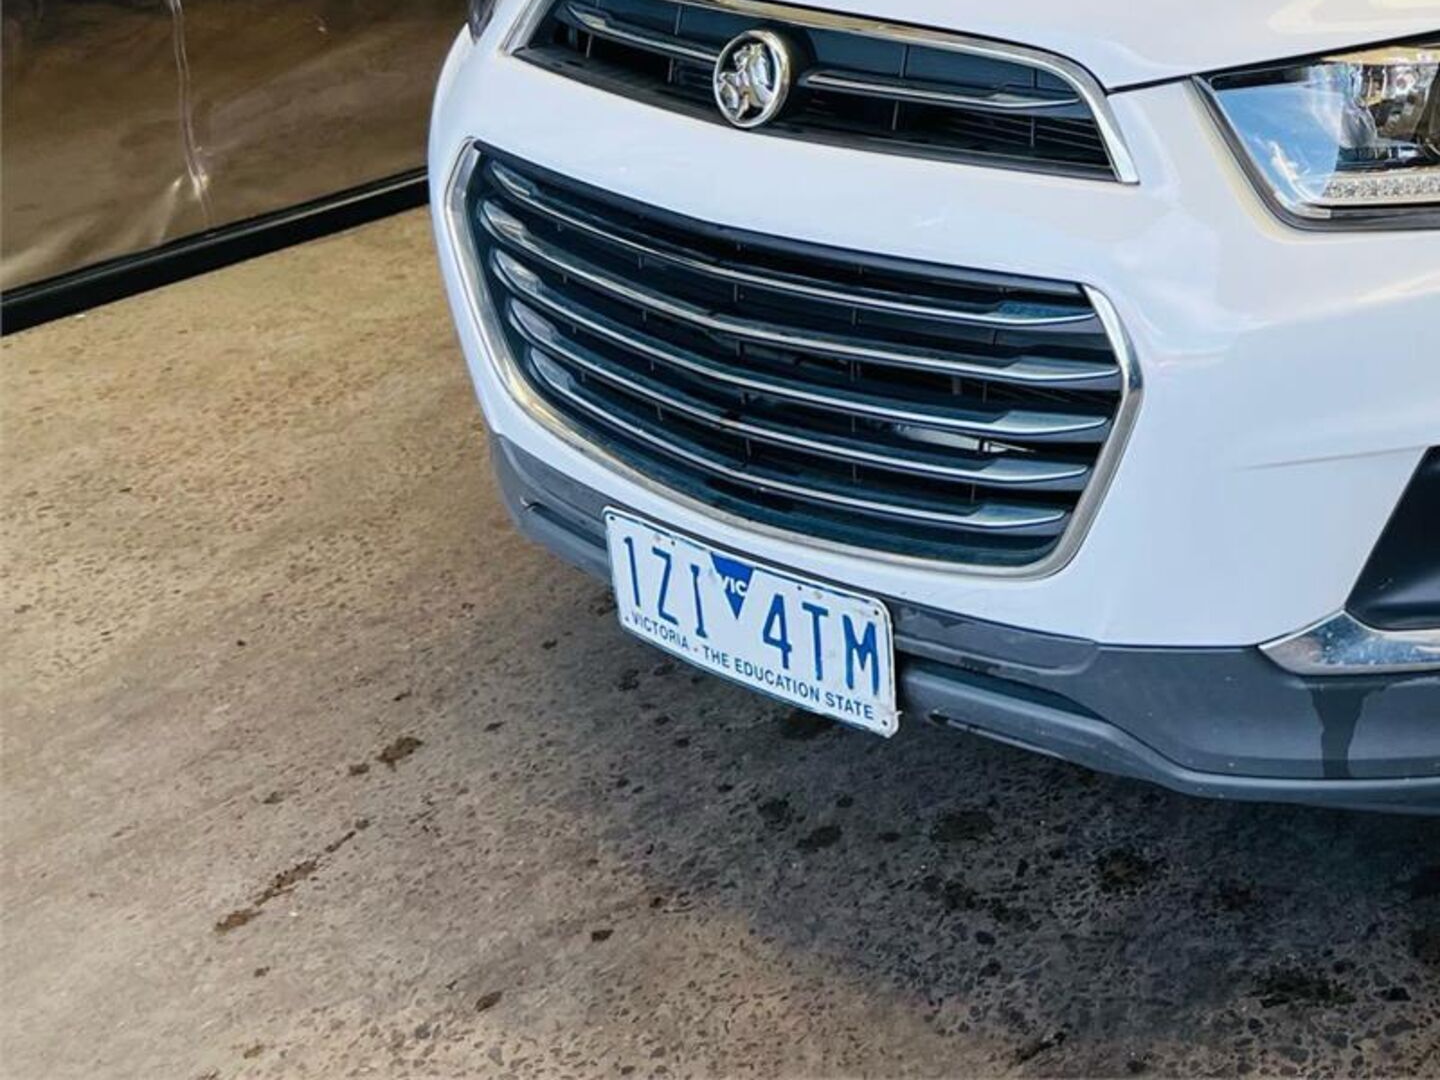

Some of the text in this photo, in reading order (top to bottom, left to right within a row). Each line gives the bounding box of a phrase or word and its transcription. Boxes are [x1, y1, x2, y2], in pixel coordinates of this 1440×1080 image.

[623, 535, 709, 640] 1ZI
[762, 592, 880, 697] 4TM
[630, 612, 690, 653] VICTORIA
[703, 646, 731, 671] THE
[733, 657, 821, 703] EDUCATION
[824, 689, 875, 722] STATE
